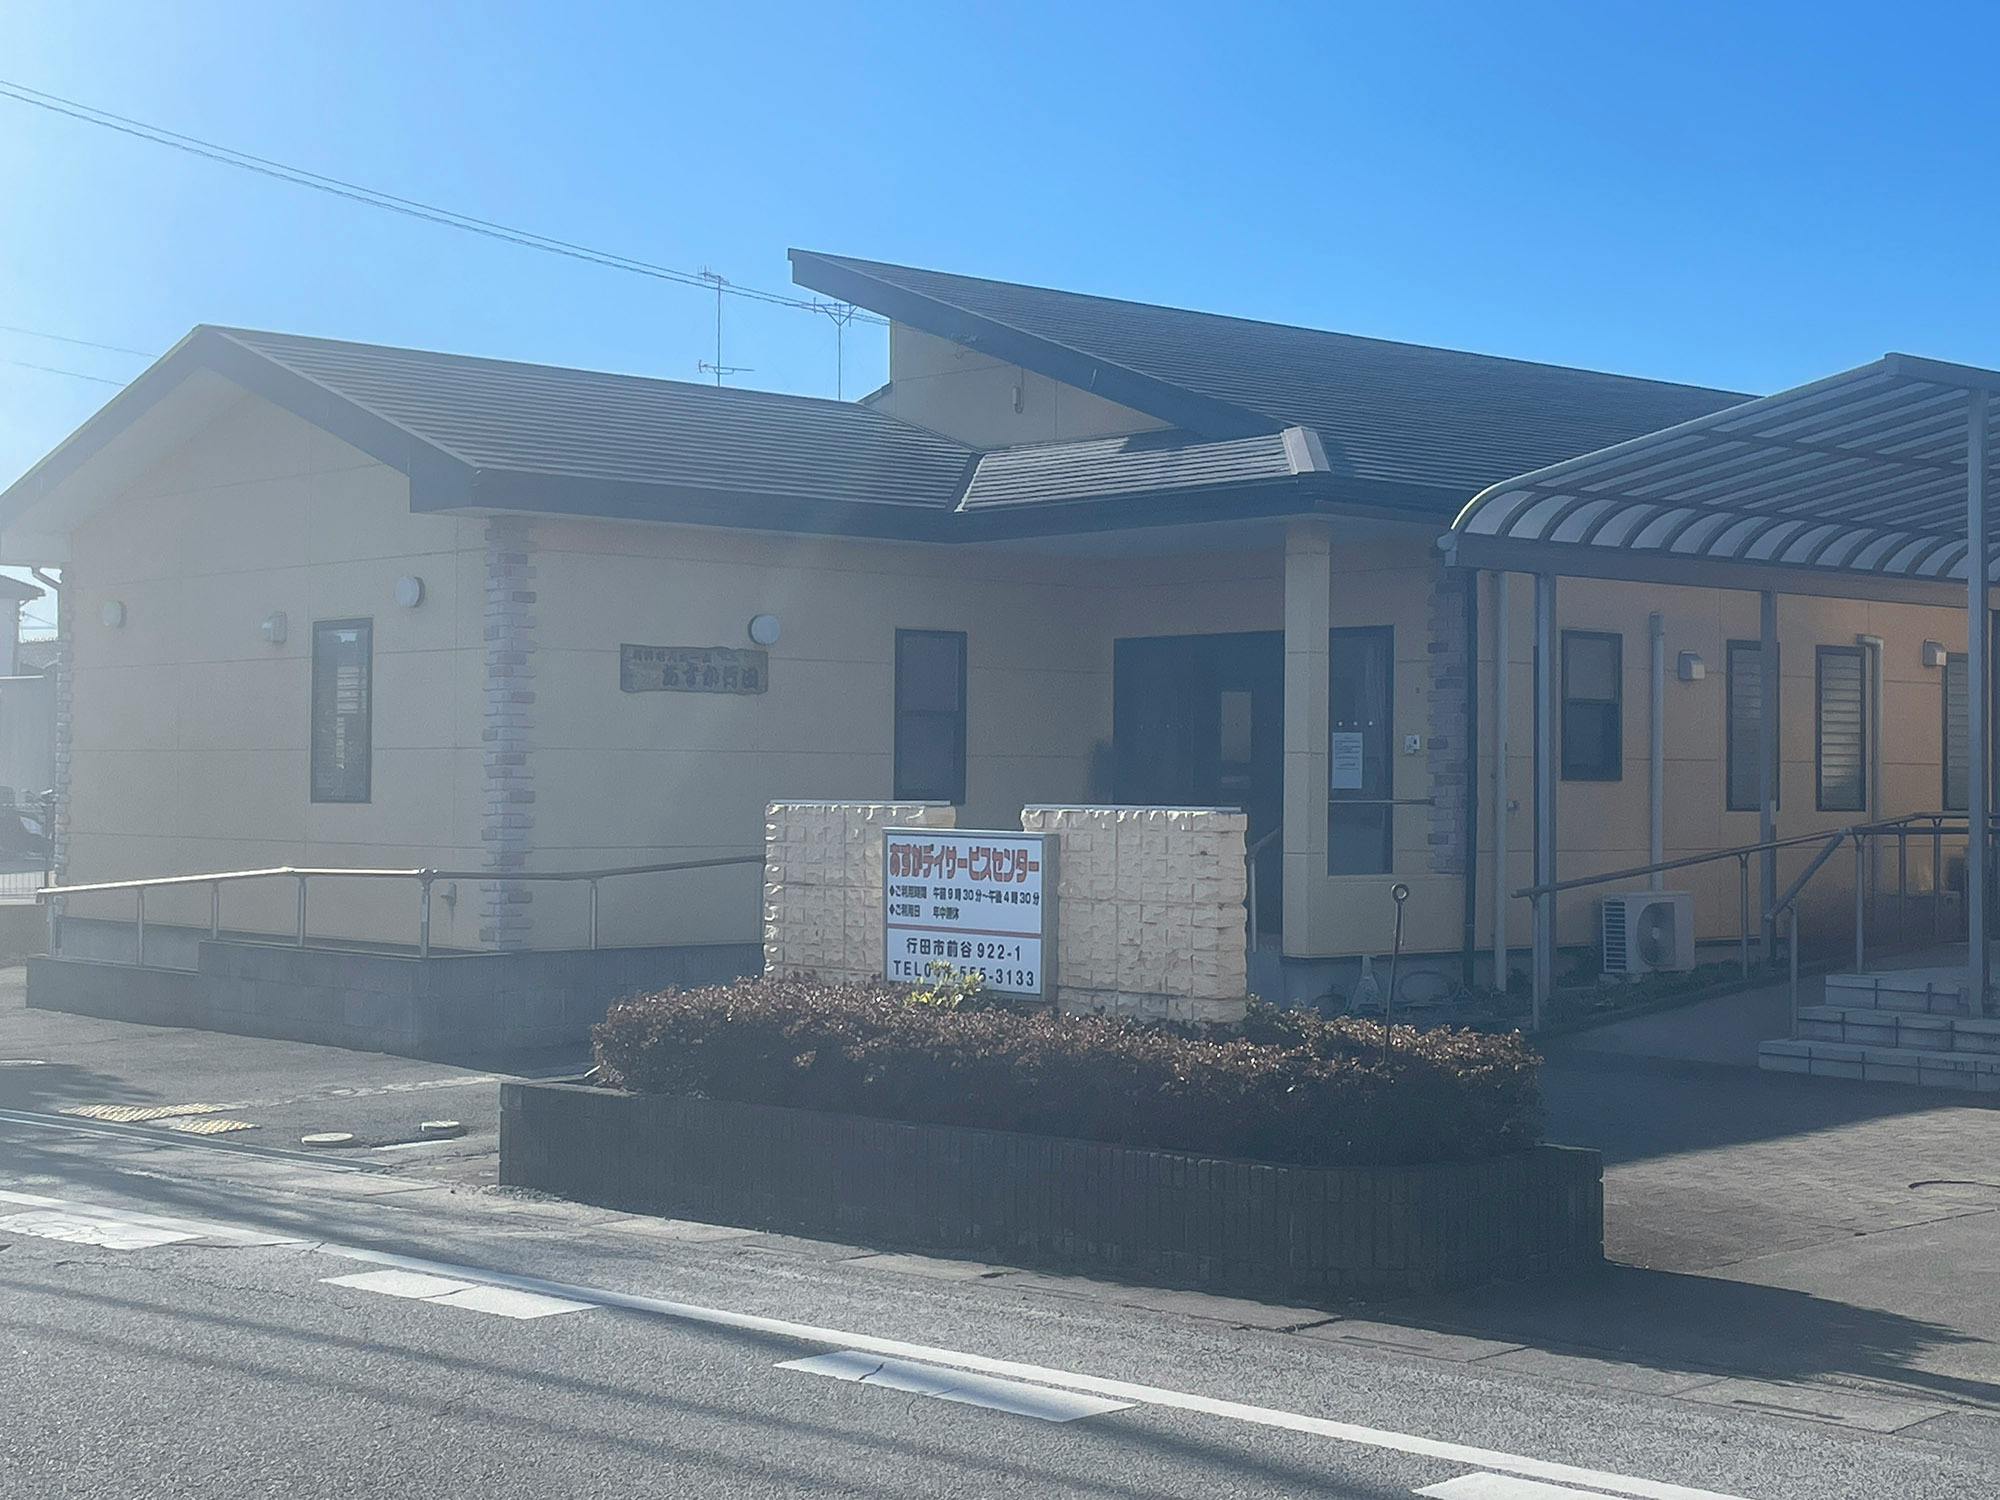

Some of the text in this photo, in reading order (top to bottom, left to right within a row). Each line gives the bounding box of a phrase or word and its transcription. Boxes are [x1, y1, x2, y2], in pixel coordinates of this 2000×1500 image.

[889, 843, 1040, 882] あすかデイサービスセンター
